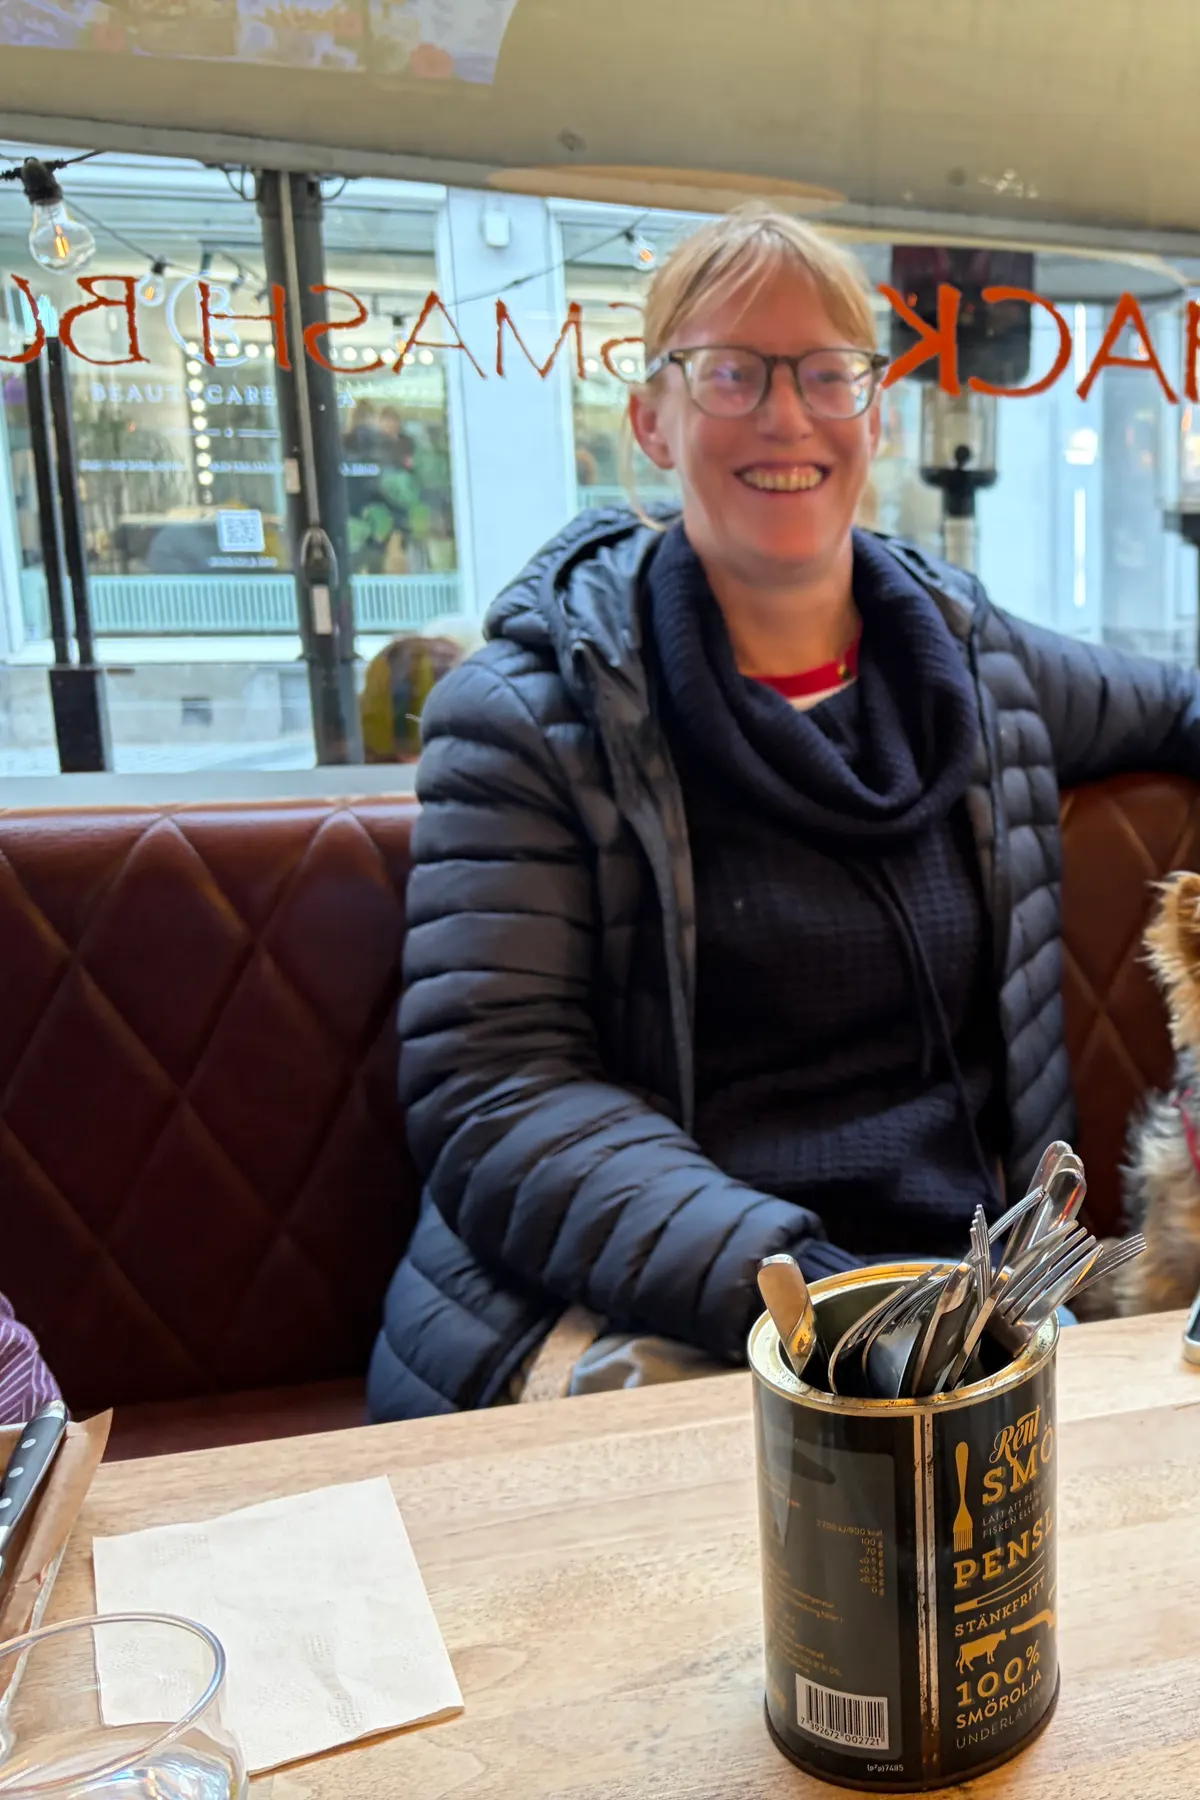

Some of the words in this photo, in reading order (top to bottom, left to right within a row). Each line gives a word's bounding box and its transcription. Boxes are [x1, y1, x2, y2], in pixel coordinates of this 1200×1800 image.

[204, 384, 277, 406] CARE
[989, 1404, 1041, 1466] Rent
[982, 1515, 1017, 1539] FISKEN
[954, 1575, 1045, 1638] STÄNKFRITT
[956, 1639, 1040, 1708] 100%
[956, 1669, 1042, 1730] SMÖROLJA
[810, 1720, 840, 1740] 392672
[845, 1734, 881, 1747] 002721
